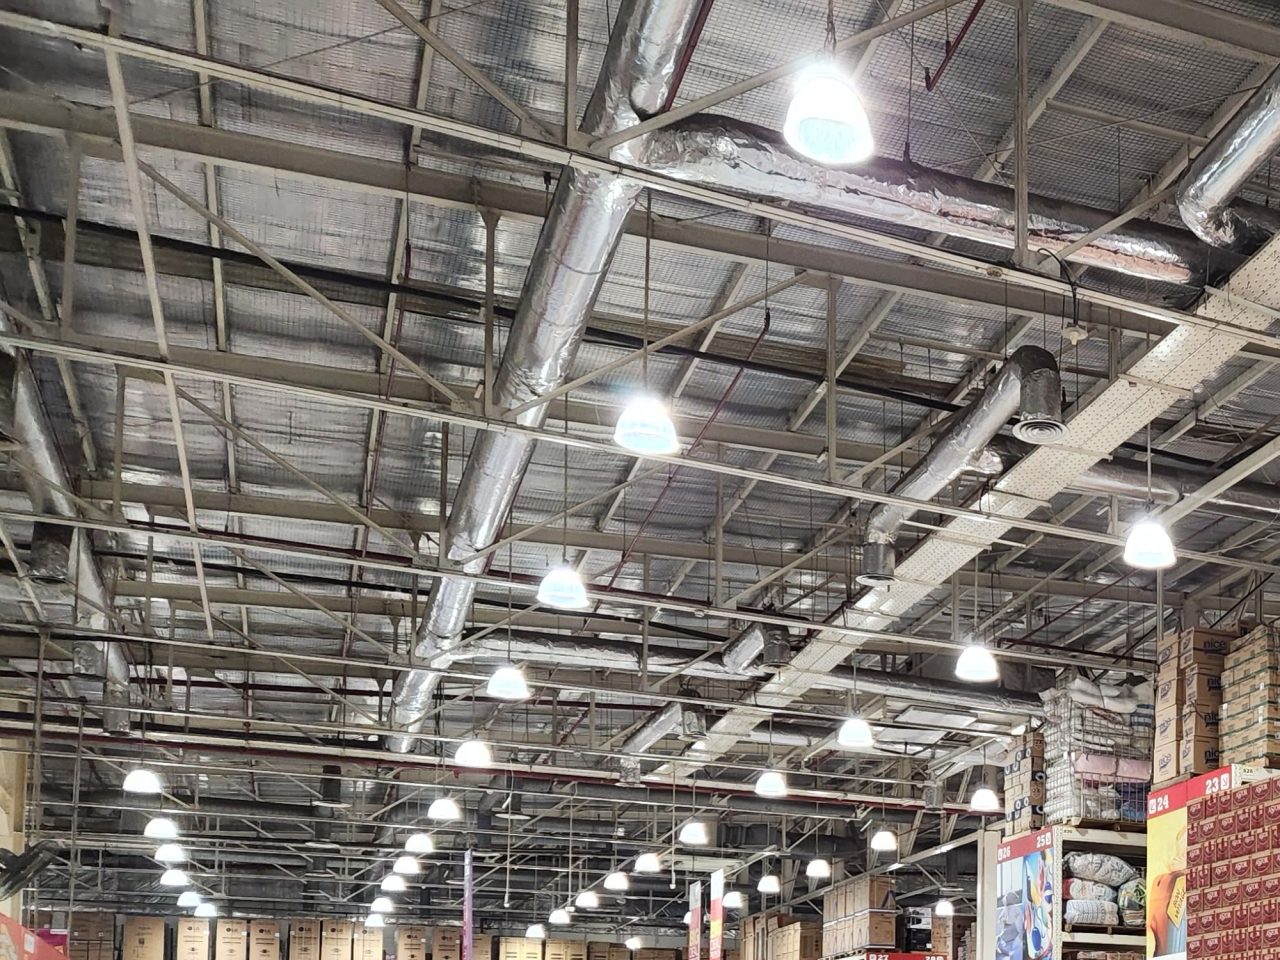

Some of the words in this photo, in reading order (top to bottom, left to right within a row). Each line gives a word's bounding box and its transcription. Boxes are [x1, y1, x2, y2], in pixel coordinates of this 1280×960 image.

[1204, 639, 1226, 649] nice
[1205, 748, 1219, 758] nic
[1205, 778, 1219, 794] 23
[1157, 795, 1169, 811] 24
[1036, 834, 1046, 848] 25
